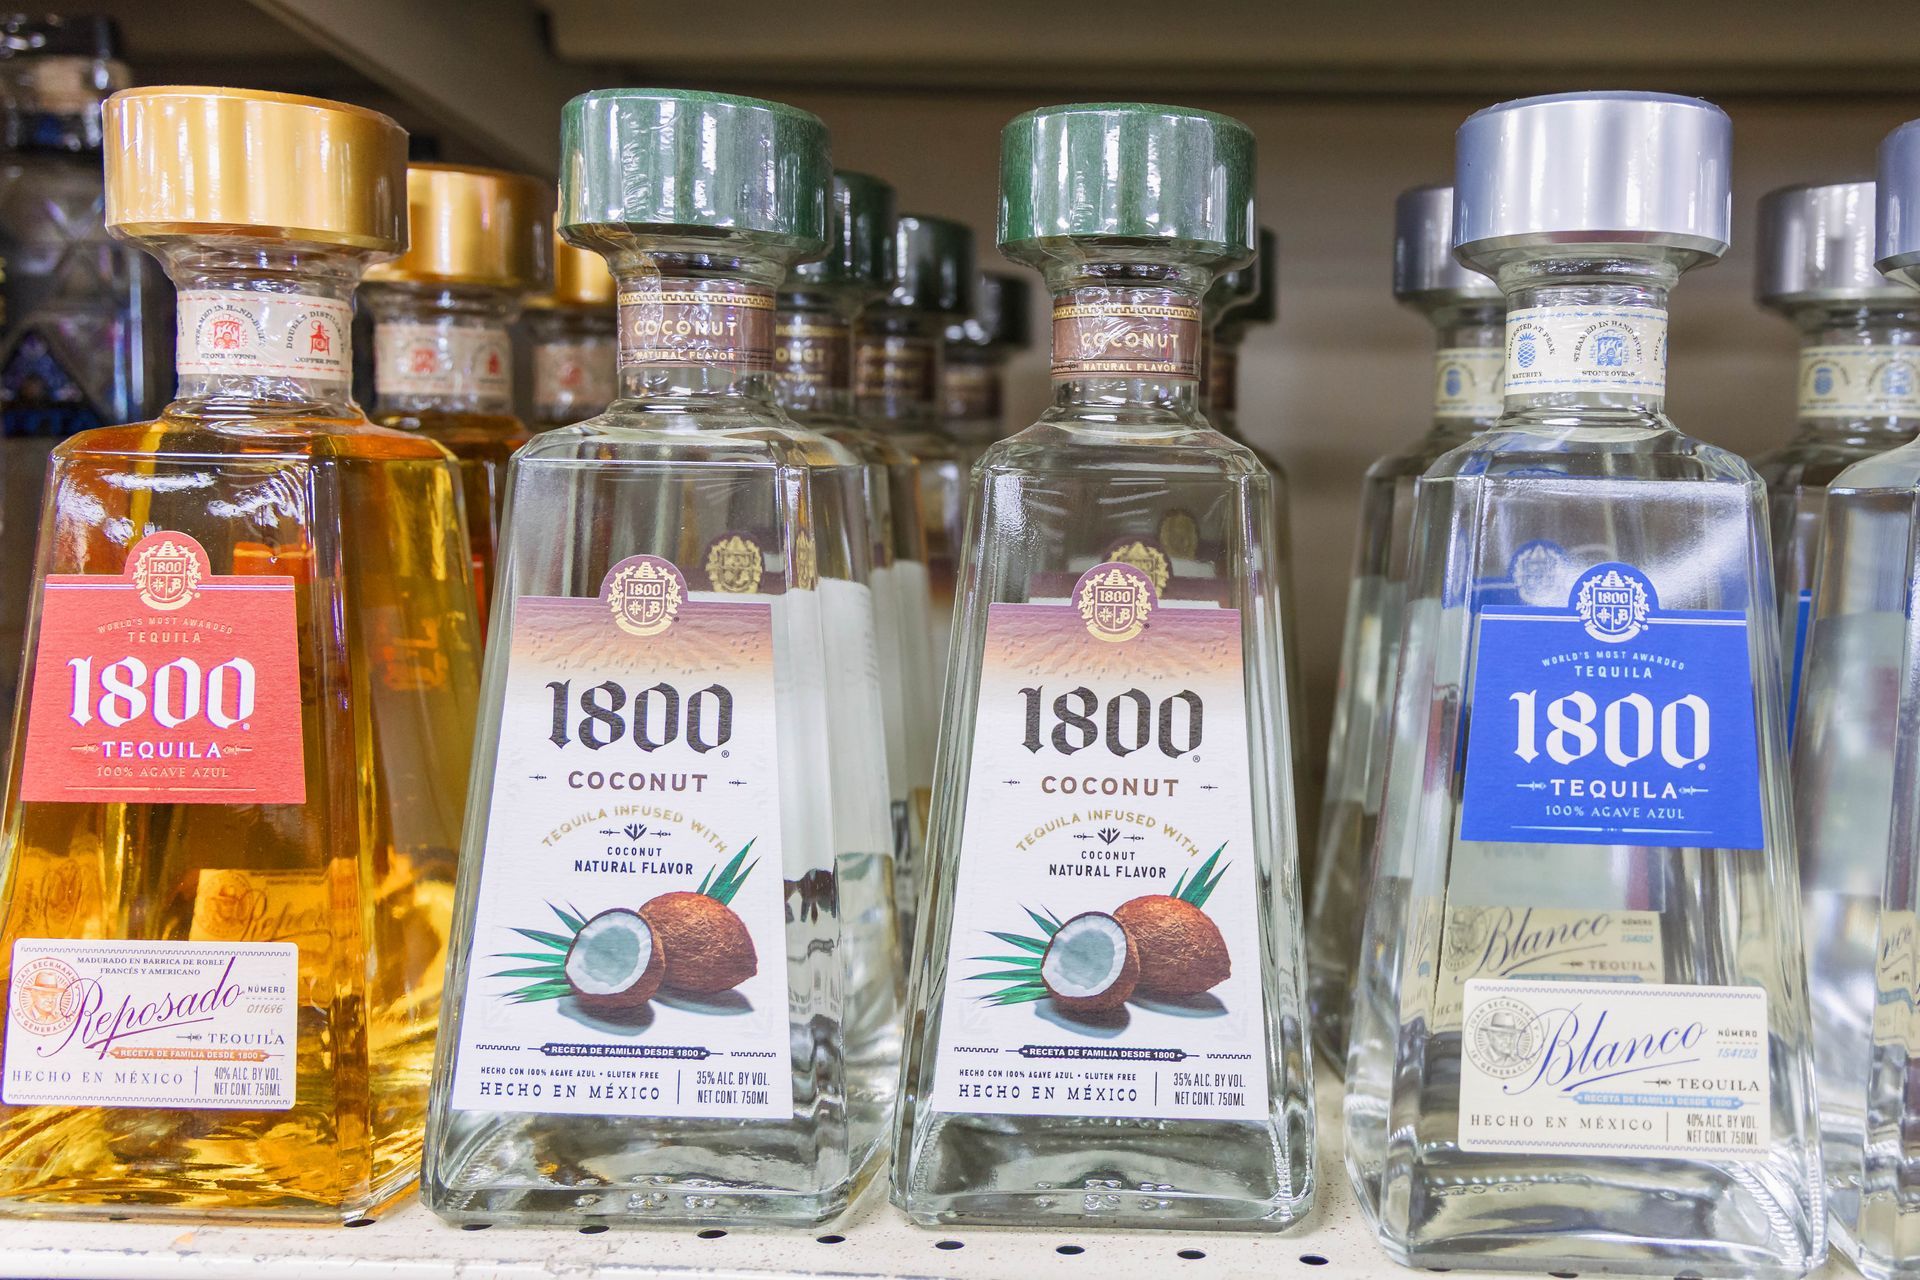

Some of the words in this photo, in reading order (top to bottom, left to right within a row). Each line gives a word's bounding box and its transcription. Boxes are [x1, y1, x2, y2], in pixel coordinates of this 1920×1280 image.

[634, 320, 738, 336] COCONUT
[1599, 320, 1609, 328] IN
[1081, 332, 1180, 348] COCONUT
[636, 351, 682, 360] NATURAL
[689, 352, 735, 360] FLAVOR
[1083, 362, 1133, 372] NATURAL
[1137, 363, 1176, 372] FLAVOR
[152, 560, 182, 574] 1800
[629, 583, 662, 596] 1800
[1099, 589, 1131, 603] 1800
[1598, 592, 1628, 604] 1800
[98, 618, 143, 634] WORLD'S
[149, 617, 178, 625] MOST
[183, 618, 233, 634] AWARDED
[128, 632, 201, 643] TEQUILA
[1542, 651, 1590, 667] WORLD'S
[1596, 650, 1626, 660] MOST
[1633, 652, 1685, 670] AWARDED
[1574, 666, 1652, 678] TEQUILA
[67, 655, 256, 729] 1800
[546, 679, 733, 754] 1800
[1018, 685, 1204, 759] 1800
[1509, 689, 1710, 769] 1800
[102, 740, 222, 758] TEQUILA
[97, 766, 134, 778] 100%
[139, 767, 186, 778] AGAVE
[192, 767, 230, 779] AZUL
[568, 770, 708, 792] COCONUT
[1041, 775, 1180, 796] COCONUT
[1550, 778, 1678, 800] TEQUILA
[1545, 805, 1585, 816] 100%
[1591, 806, 1640, 818] AGAVE
[1646, 808, 1685, 820] AZUL
[542, 806, 608, 848] TEQUILA
[614, 804, 684, 823] INFUSED
[691, 819, 728, 854] WITH
[1016, 812, 1081, 851] TEQUILA
[1088, 809, 1156, 828] INFUSED
[1163, 823, 1200, 857] WITH
[607, 846, 662, 857] COCONUT
[1080, 850, 1136, 861] COCONUT
[574, 860, 636, 874] NATURAL
[642, 862, 694, 875] FLAVOR
[1049, 864, 1110, 878] NATURAL
[1116, 866, 1167, 879] FLAVOR
[1454, 906, 1615, 984] Blanco
[77, 957, 127, 965] MADURADO
[1589, 960, 1656, 970] TEQUILA
[148, 968, 200, 976] AMERICANO
[247, 984, 286, 994] NÚMERO
[37, 956, 245, 1060] Reposado
[208, 1032, 286, 1046] TEQUILA
[1718, 1028, 1758, 1038] NÚMERO
[551, 1046, 588, 1054] RECETA
[605, 1048, 642, 1056] FAMILIA
[644, 1048, 674, 1056] DESDE
[676, 1049, 699, 1057] 1800
[1030, 1048, 1065, 1056] RECETA
[1503, 1002, 1708, 1094] Blanco
[238, 1052, 258, 1060] 1800
[12, 1070, 72, 1082] HECHO
[82, 1072, 104, 1084] EN
[115, 1069, 184, 1085] MÉXICO
[214, 1067, 230, 1080] 40%
[252, 1068, 264, 1081] BY
[265, 1068, 282, 1081] VOL.
[481, 1066, 506, 1074] HECHO
[509, 1068, 524, 1076] CON
[528, 1068, 547, 1076] 100%
[550, 1069, 574, 1077] AGAVE
[577, 1070, 596, 1078] AZUL
[607, 1070, 636, 1078] GLUTEN
[640, 1071, 660, 1079] FREE
[696, 1071, 715, 1085] 35%
[717, 1072, 736, 1086] ALC.
[738, 1072, 750, 1086] BY
[752, 1072, 770, 1086] VOL.
[960, 1069, 984, 1077] HECHO
[988, 1070, 1002, 1078] CON
[1006, 1070, 1025, 1078] 100%
[1028, 1071, 1052, 1079] AGAVE
[1055, 1072, 1074, 1080] AZUL
[1085, 1072, 1114, 1080] GLUTEN
[1117, 1073, 1136, 1081] FREE
[1174, 1072, 1192, 1086] 35%
[1194, 1073, 1212, 1087] ALC.
[1214, 1074, 1226, 1088] BY
[1228, 1074, 1246, 1088] VOL.
[214, 1083, 230, 1096] NET
[255, 1084, 281, 1096] 750ML
[480, 1082, 542, 1097] HECHO
[553, 1084, 576, 1098] EN
[589, 1083, 660, 1100] MÉXICO
[1677, 1078, 1760, 1092] TEQUILA
[697, 1090, 712, 1104] NET
[741, 1091, 769, 1104] 750ML
[959, 1084, 1020, 1099] HECHO
[1032, 1086, 1055, 1100] EN
[1068, 1085, 1137, 1102] MÉXICO
[1174, 1091, 1190, 1105] NET
[1192, 1092, 1215, 1106] CONT.
[1218, 1092, 1246, 1106] 750ML
[1638, 1096, 1674, 1104] FAMILIA
[1471, 1114, 1534, 1128] HECHO
[1546, 1116, 1568, 1128] EN
[1580, 1112, 1653, 1132] MÉXICO
[1686, 1114, 1704, 1128] 40%
[1727, 1115, 1740, 1128] BY
[1741, 1115, 1759, 1129] VOL.
[1686, 1130, 1702, 1143] NET
[1731, 1130, 1758, 1145] 750ML
